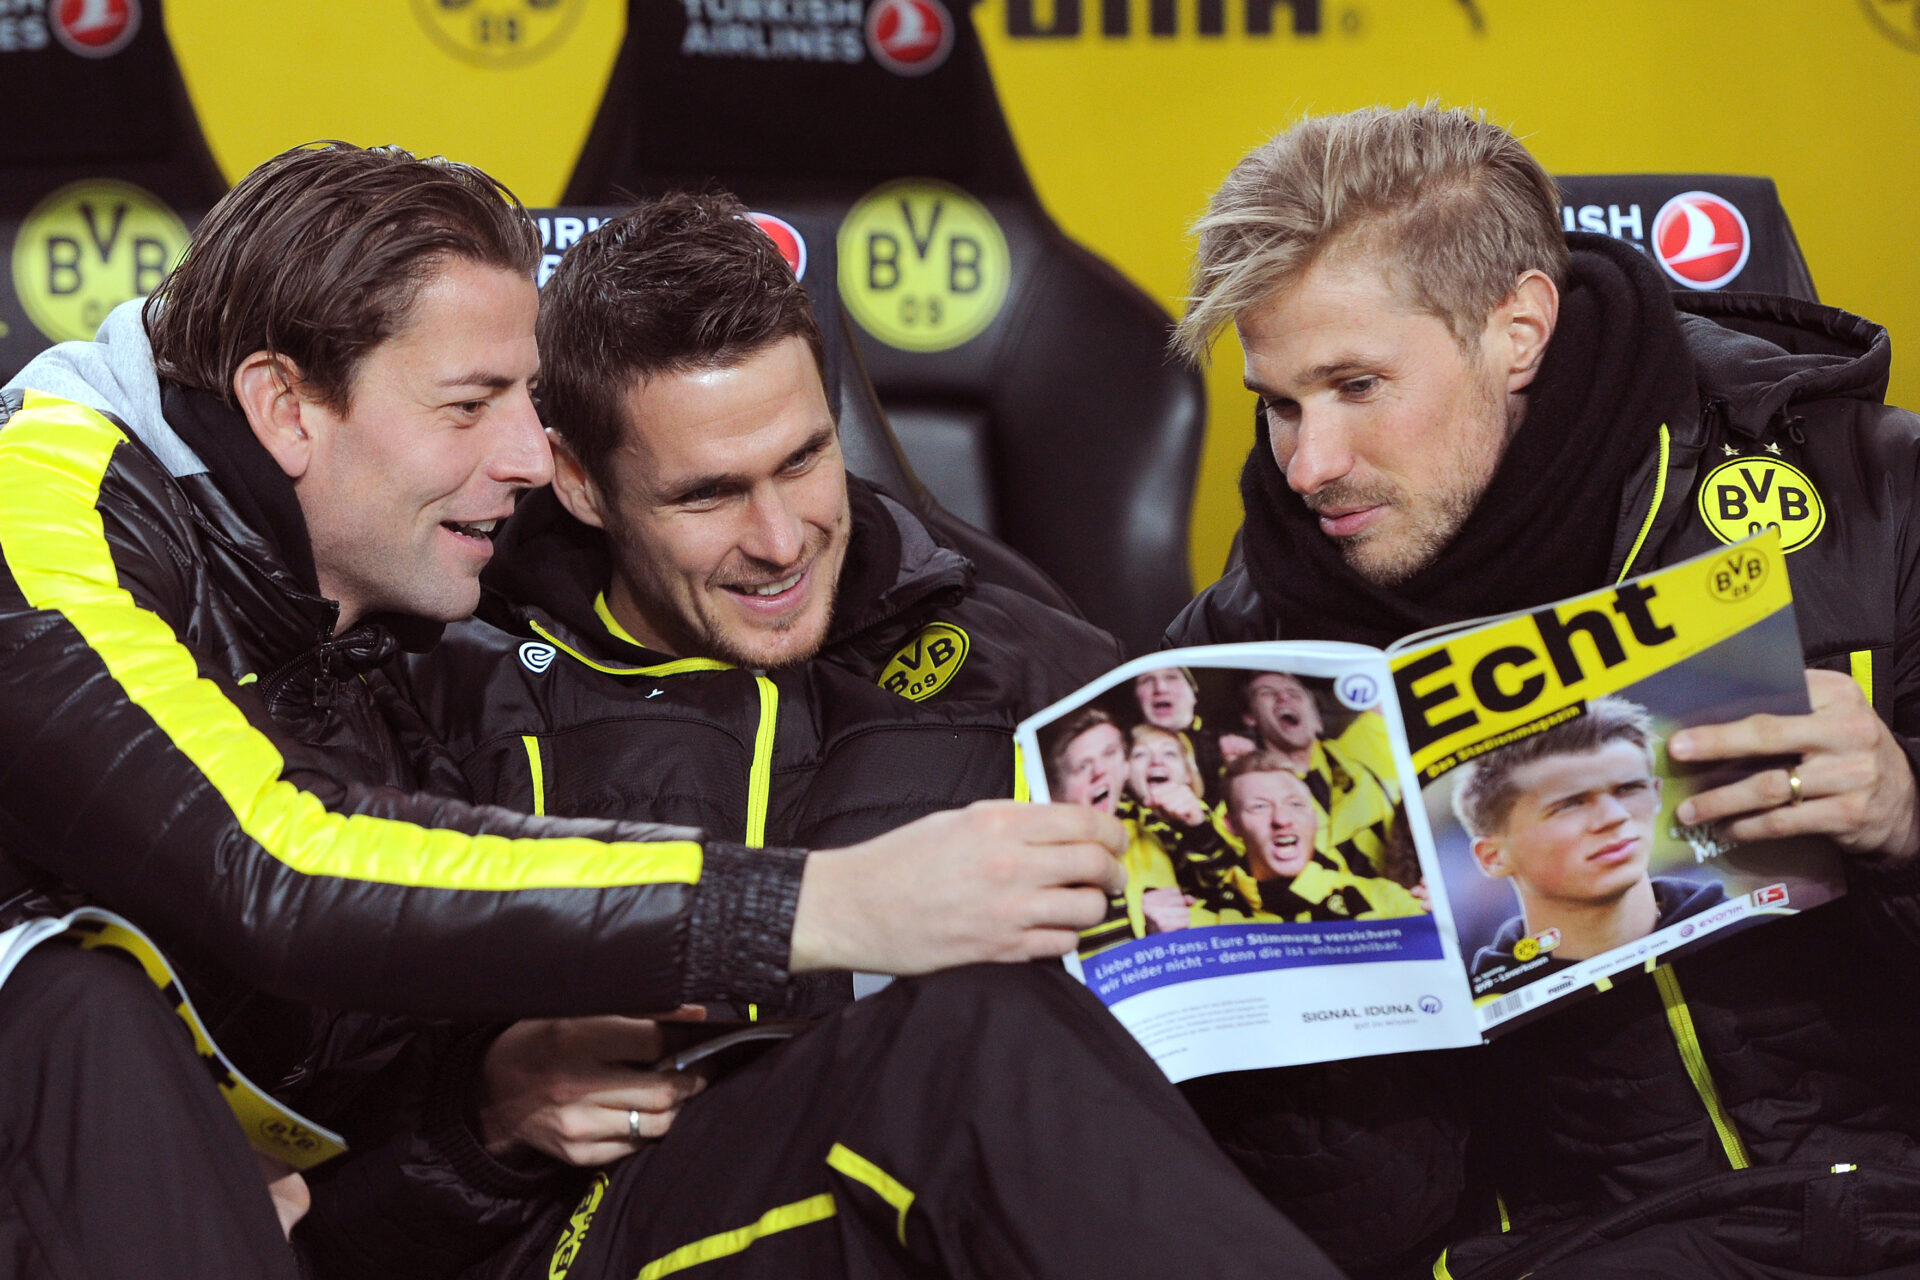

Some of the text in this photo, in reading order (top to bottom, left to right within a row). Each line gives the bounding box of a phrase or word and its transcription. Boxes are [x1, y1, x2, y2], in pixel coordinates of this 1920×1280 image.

[45, 202, 168, 296] BVB
[867, 198, 983, 293] BVB
[1716, 468, 1810, 521] BVB
[1715, 552, 1763, 593] BVB
[883, 637, 956, 694] BVB
[910, 673, 938, 695] 09
[1392, 582, 1677, 755] Echt
[1426, 756, 1456, 779] Das
[1095, 928, 1402, 980] Liebe BVB-Fans: Eure Stimmung versichern
[1099, 976, 1121, 996] wir
[1121, 963, 1163, 985] leider
[1165, 954, 1203, 973] nicht
[1219, 949, 1256, 964] denn
[1258, 947, 1283, 960] die
[1285, 945, 1305, 957] ist
[1302, 1003, 1414, 1024] SIGNAL IDUNA
